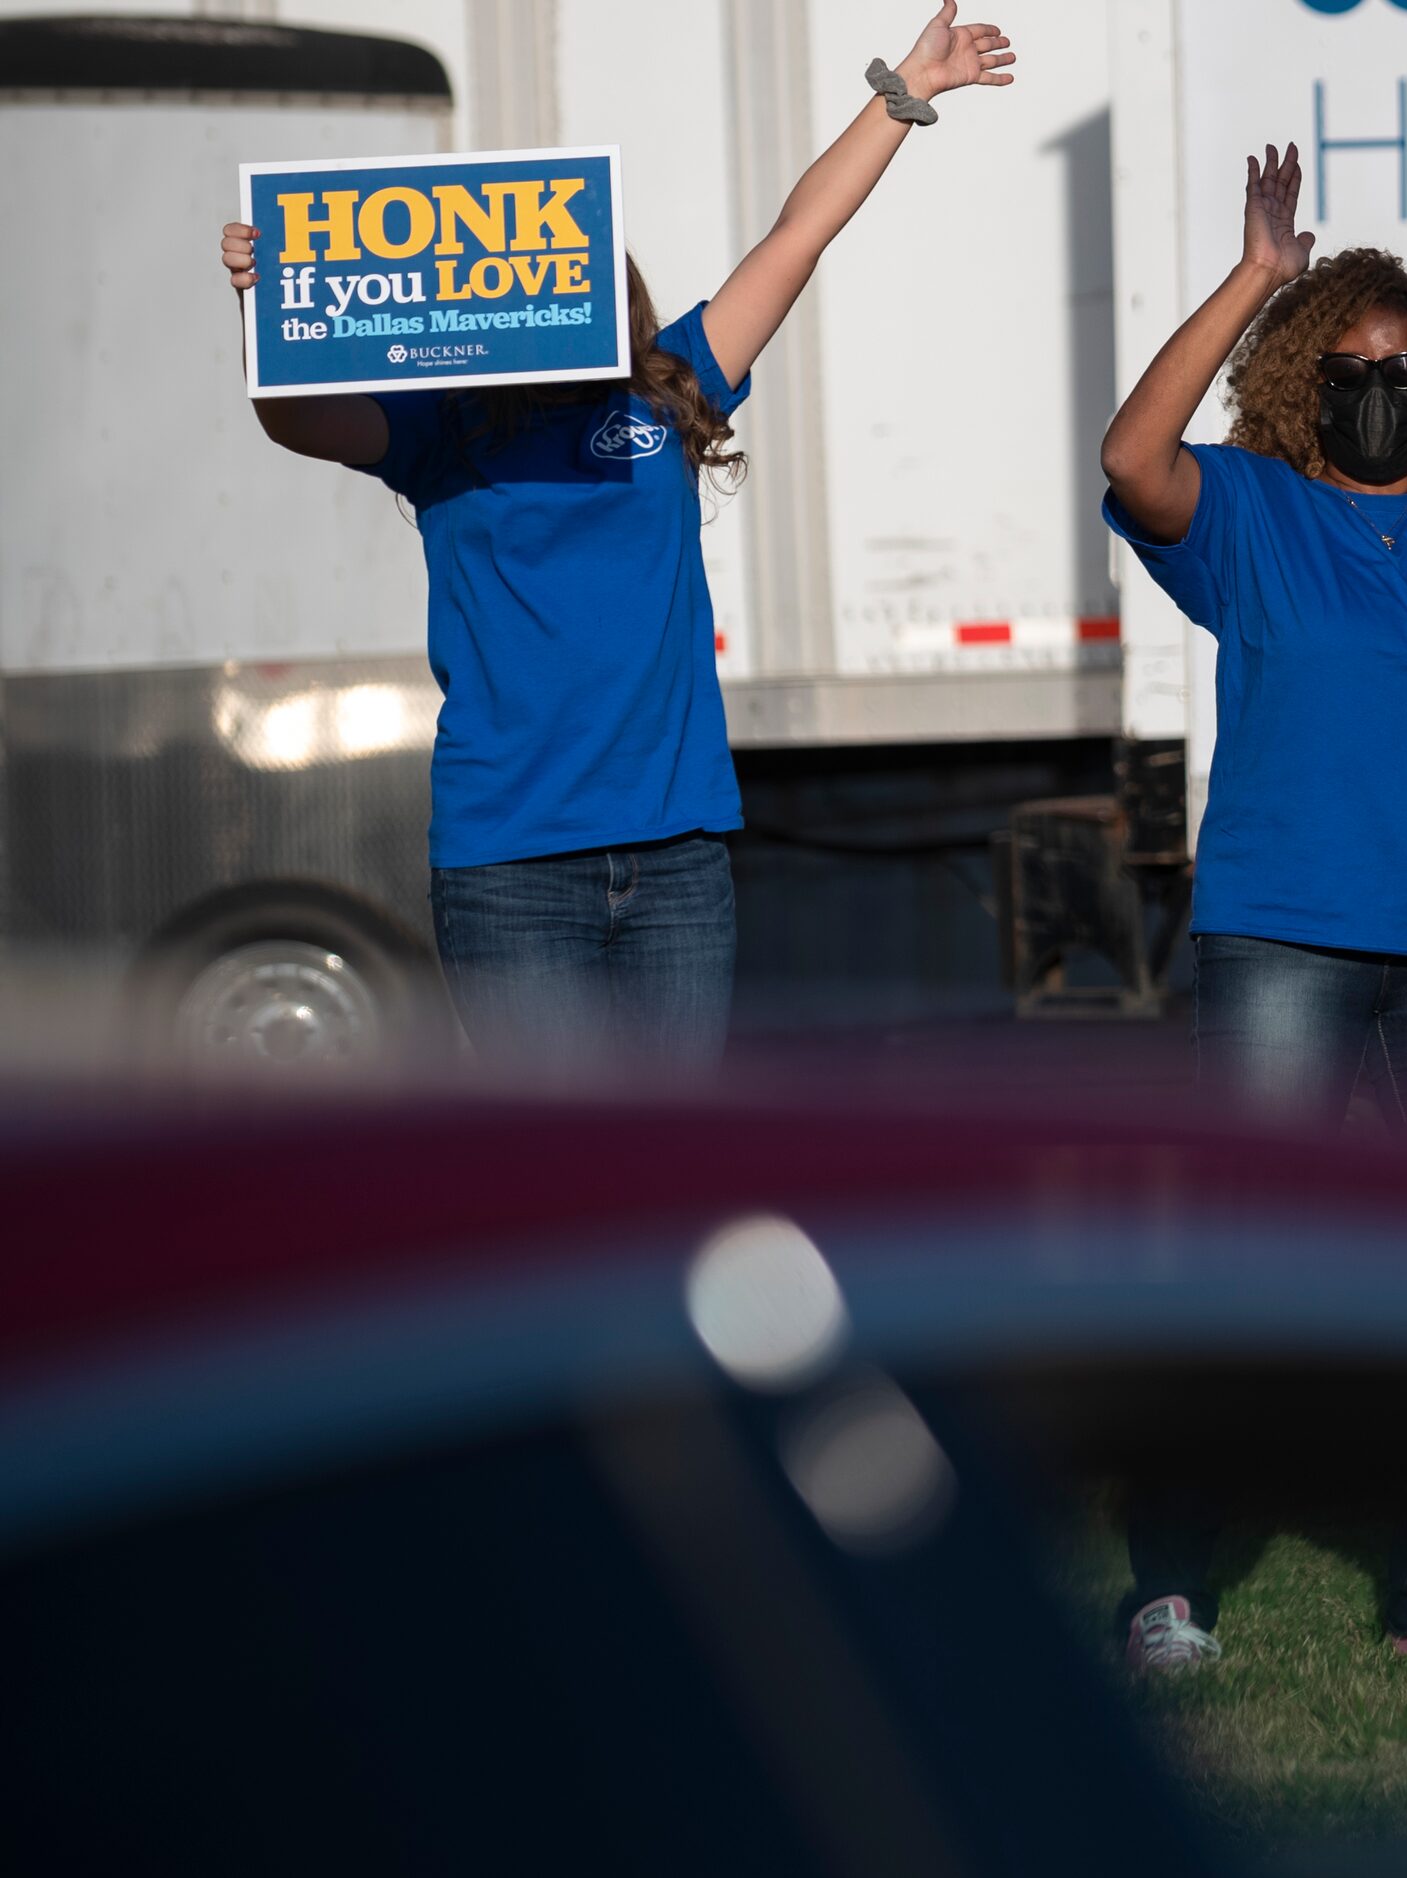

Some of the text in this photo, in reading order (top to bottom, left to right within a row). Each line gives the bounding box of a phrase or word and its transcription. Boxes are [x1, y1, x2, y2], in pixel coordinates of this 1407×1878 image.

[277, 177, 590, 264] HONK
[279, 252, 591, 317] if you LOVE
[281, 302, 592, 341] the Dallas Mavericks!
[410, 344, 485, 359] BUCKNER
